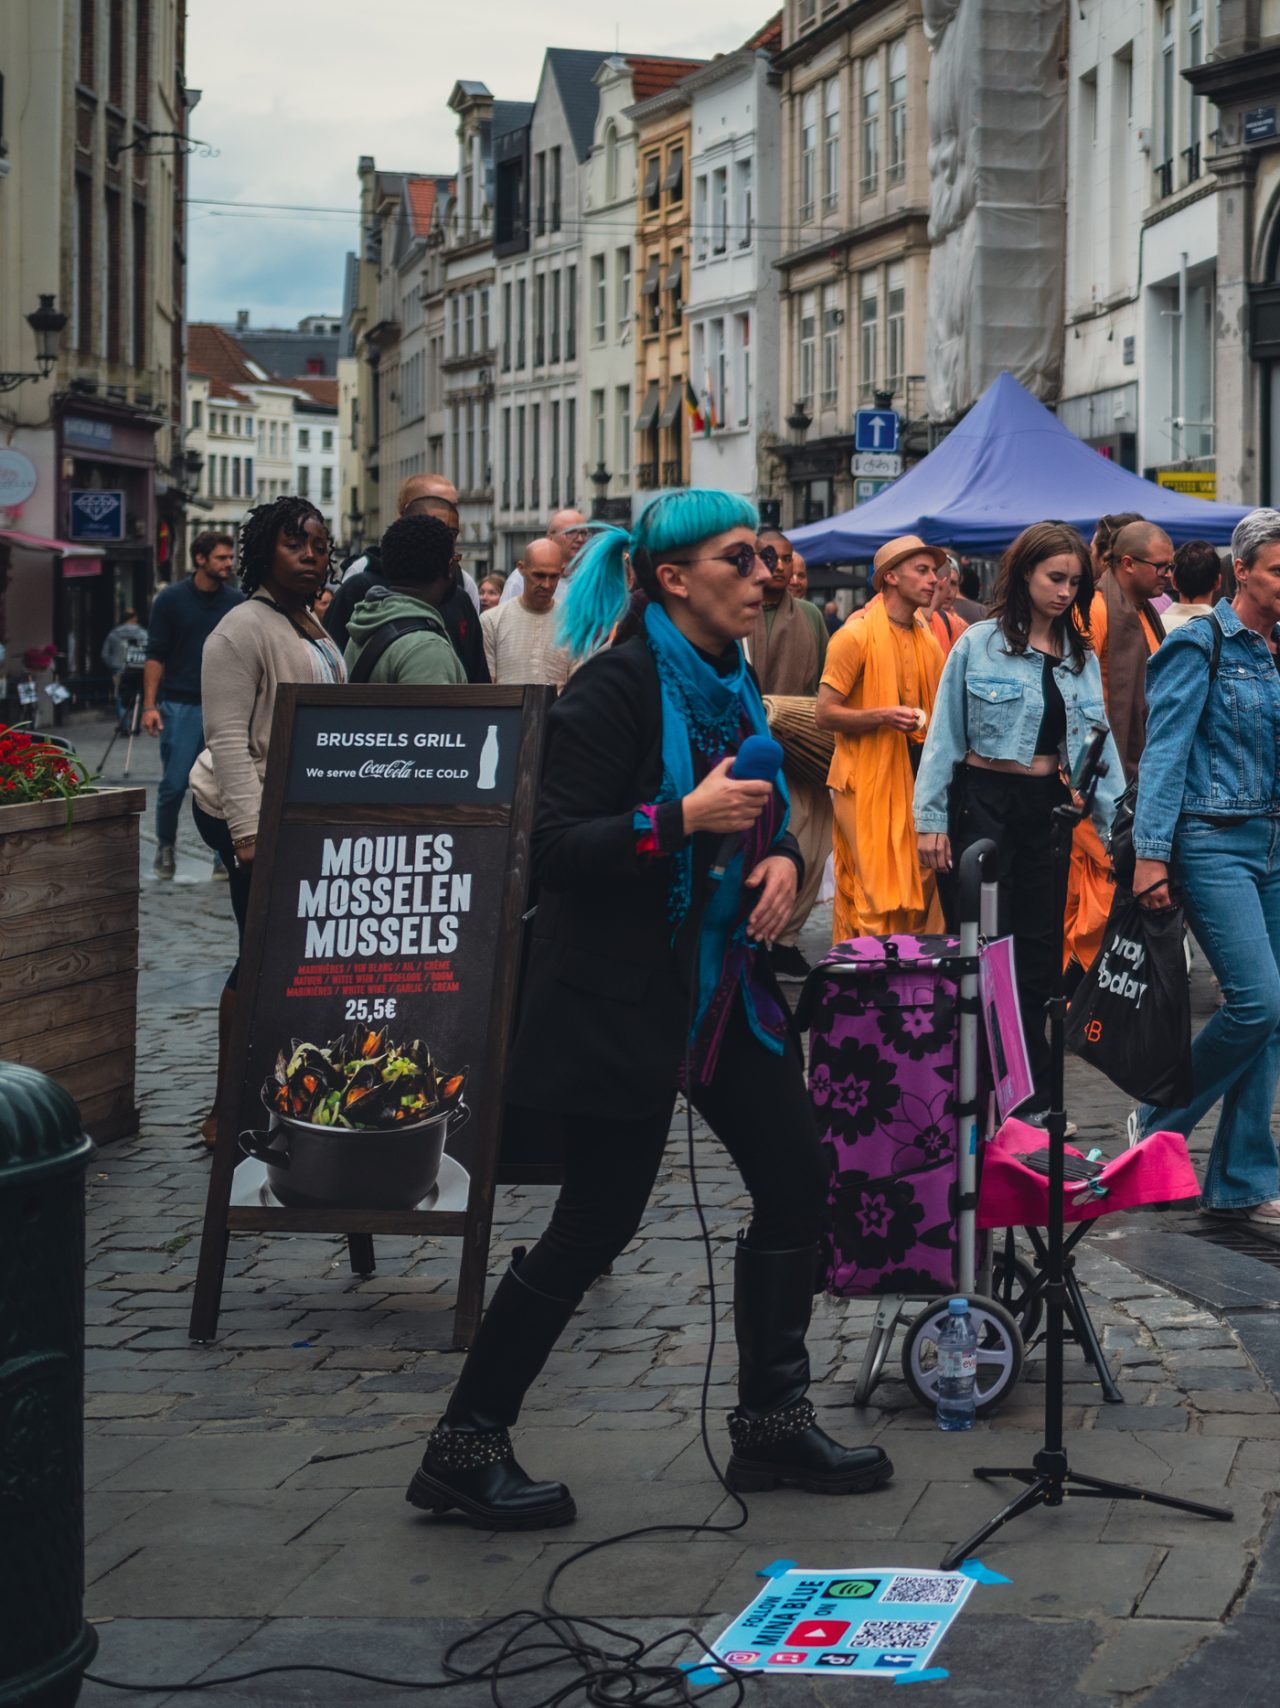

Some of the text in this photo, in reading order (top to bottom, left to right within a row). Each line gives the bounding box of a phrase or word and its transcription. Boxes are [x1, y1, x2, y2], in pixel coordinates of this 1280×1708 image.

[316, 732, 466, 748] BRUSSELS GRILL
[306, 767, 324, 778] We
[326, 768, 357, 778] serve
[415, 768, 433, 779] ICE
[436, 768, 469, 779] COLD
[321, 833, 454, 876] MOULES
[297, 874, 472, 918] MOSSELEN
[304, 914, 459, 959] MUSSELS
[344, 997, 398, 1023] 25,5€
[742, 1595, 783, 1628] FOLLOW
[751, 1580, 825, 1647] MINA BLUE
[814, 1603, 838, 1616] ON
